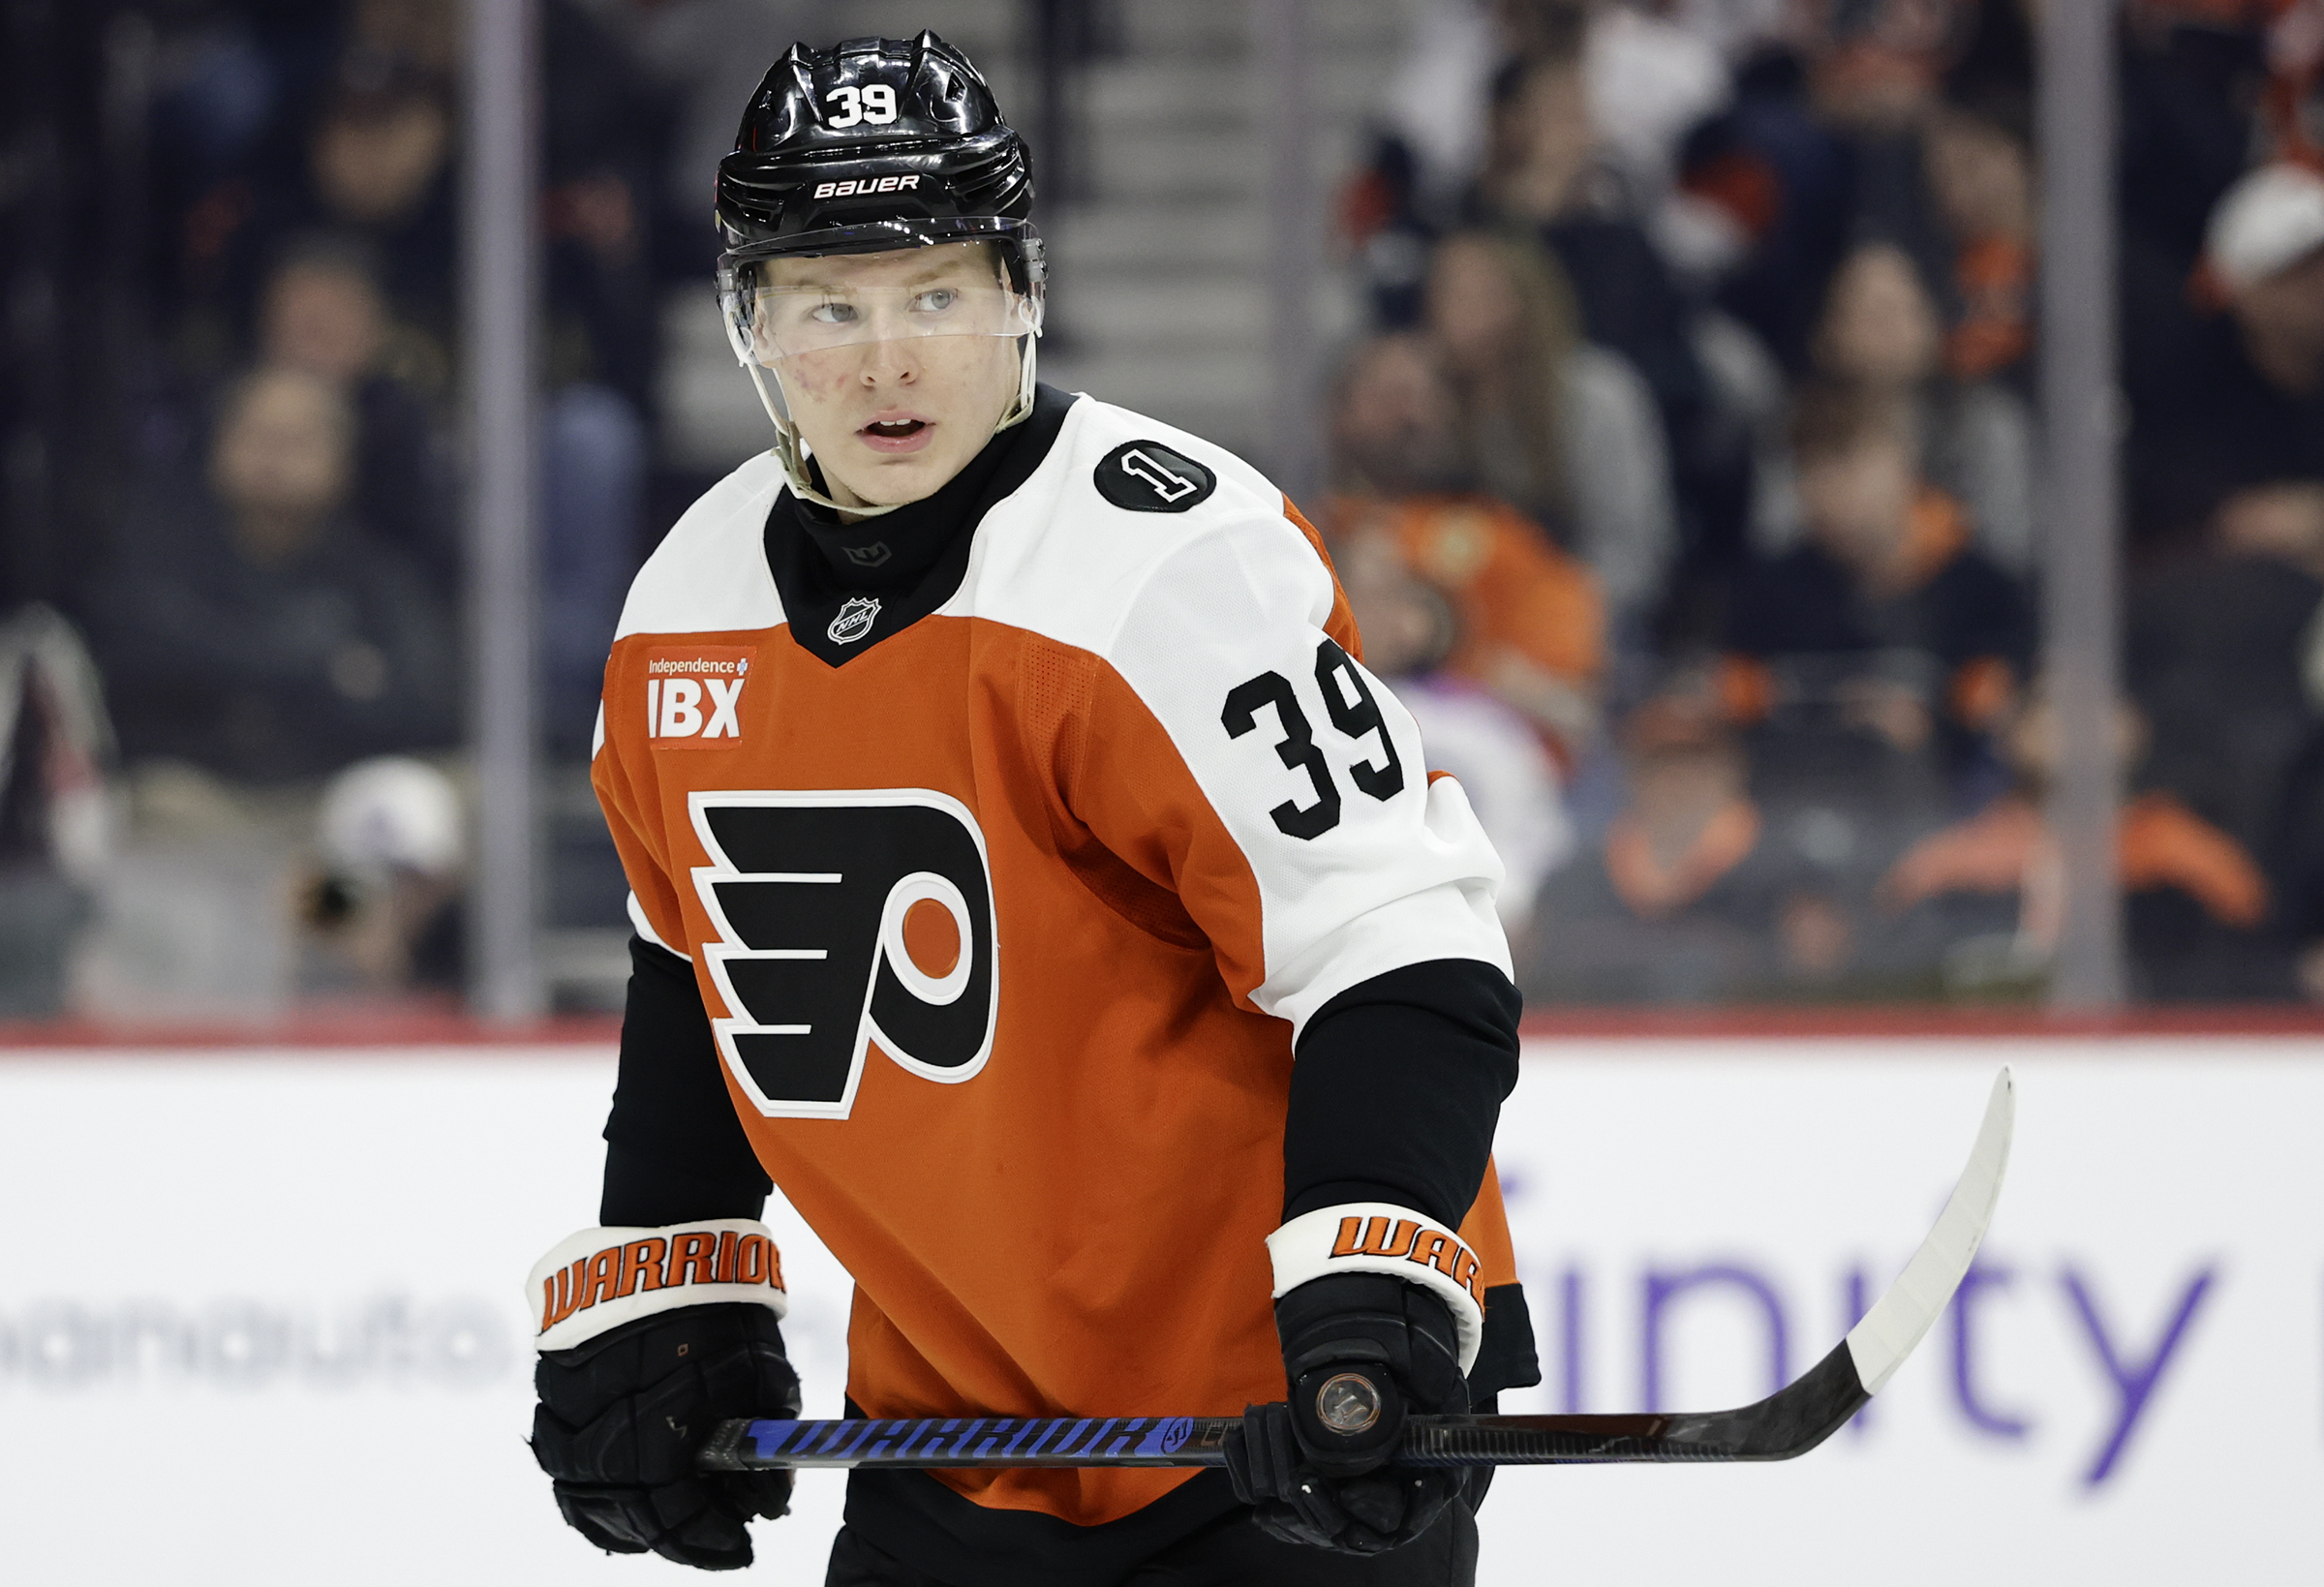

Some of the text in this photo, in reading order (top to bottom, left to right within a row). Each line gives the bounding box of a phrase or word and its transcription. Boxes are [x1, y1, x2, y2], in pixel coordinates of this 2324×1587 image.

[826, 83, 897, 129] 39
[1120, 448, 1198, 503] 1
[836, 610, 870, 633] NHL
[649, 656, 735, 676] Independence
[648, 678, 746, 738] IBX
[1220, 637, 1404, 840] 39
